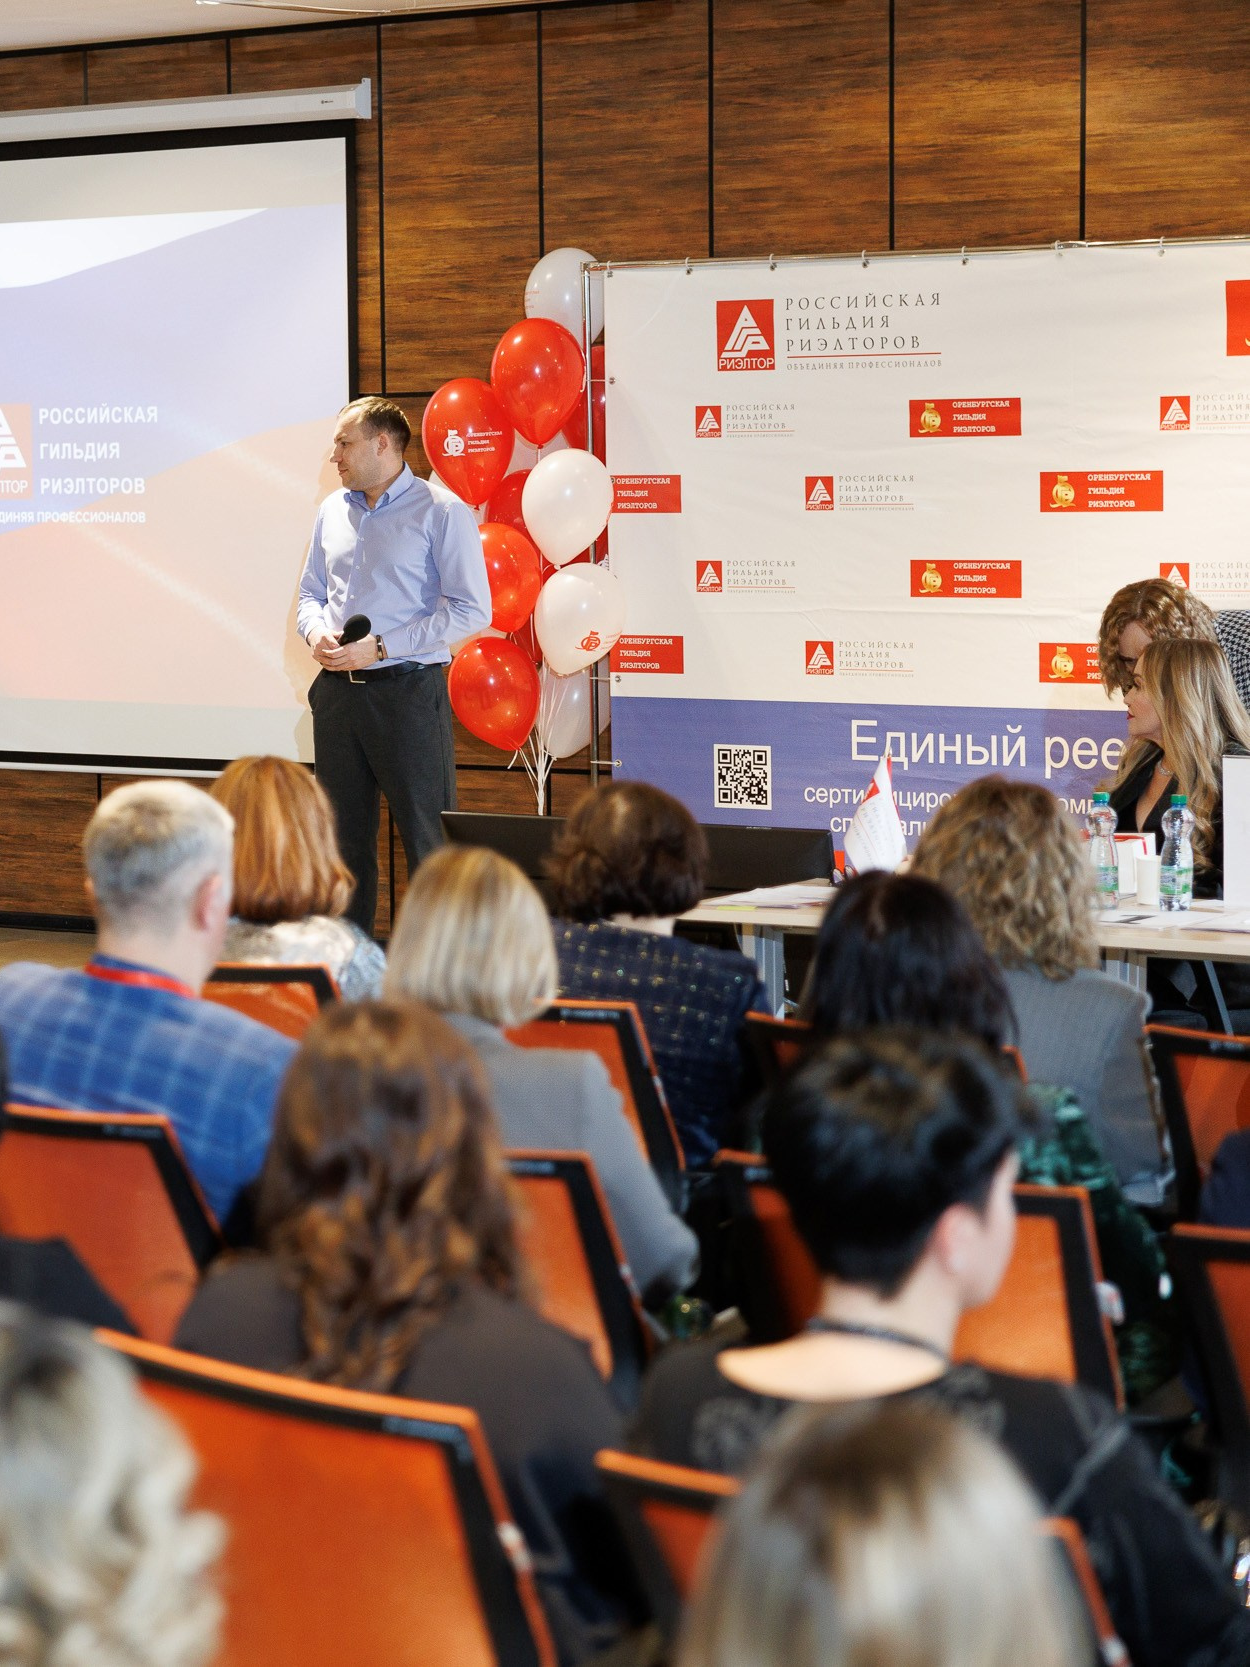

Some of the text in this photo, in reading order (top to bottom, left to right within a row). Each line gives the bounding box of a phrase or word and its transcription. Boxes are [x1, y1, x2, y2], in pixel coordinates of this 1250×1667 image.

[785, 292, 941, 311] РОССИЙСКАЯ
[786, 315, 890, 331] ГИЛЬДИЯ
[786, 336, 920, 352] РИЭЛТОРОВ
[718, 358, 774, 370] РИЭЛТОР
[787, 359, 942, 371] ОБЪЕДИНЯЯ ПРОФЕССИОНАЛОВ
[726, 403, 795, 411] РОССИЙСКАЯ
[38, 403, 158, 425] РОССИЙСКАЯ
[953, 413, 986, 421] ГИЛЬДИЯ
[39, 442, 120, 462] ГИЛЬДИЯ
[839, 474, 914, 482] РОССИЙСКАЯ
[1087, 473, 1151, 482] ОРЕНБУРГСКАЯ
[40, 478, 146, 496] РИЭЛТОРОВ
[1088, 487, 1125, 495] ГИЛЬДИЯ
[1088, 500, 1135, 508] РИЭЛТОРОВ
[37, 511, 146, 524] ПРОФЕССИОНАЛОВ
[953, 562, 1011, 570] ОРЕНБУРГСКАЯ
[953, 574, 987, 582] ГИЛЬДИЯ
[619, 637, 673, 645] ОРЕНБУРГСКАЯ
[839, 640, 914, 649] РОССИЙСКАЯ
[839, 651, 890, 659] ГИЛЬДИЯ
[851, 719, 1128, 779] Единый рее
